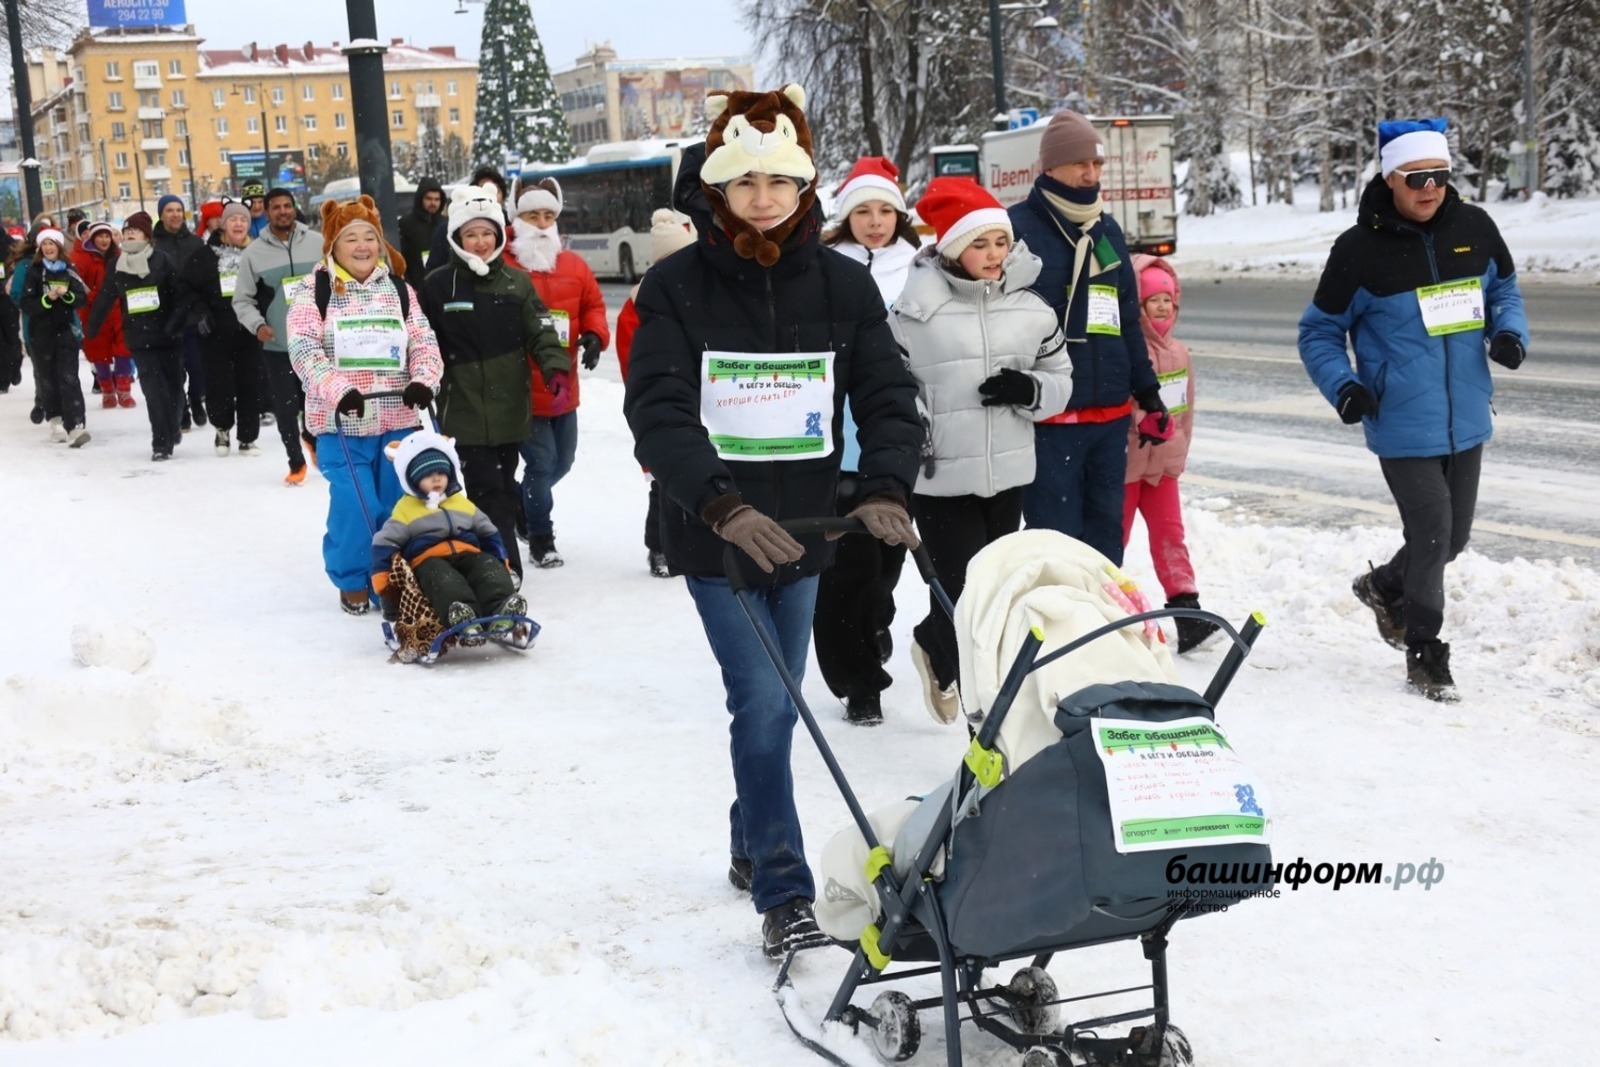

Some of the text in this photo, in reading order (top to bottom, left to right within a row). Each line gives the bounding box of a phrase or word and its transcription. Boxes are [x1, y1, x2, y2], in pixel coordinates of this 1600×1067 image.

[118, 8, 165, 21] 294 22 99
[717, 360, 751, 370] Забег
[754, 361, 806, 371] обещаний
[774, 382, 802, 390] ОБЕЩАЮ
[717, 396, 752, 408] ХОРОШО
[1107, 725, 1211, 741] Забег обещаний
[1176, 750, 1214, 759] ОБЕЩАЮ
